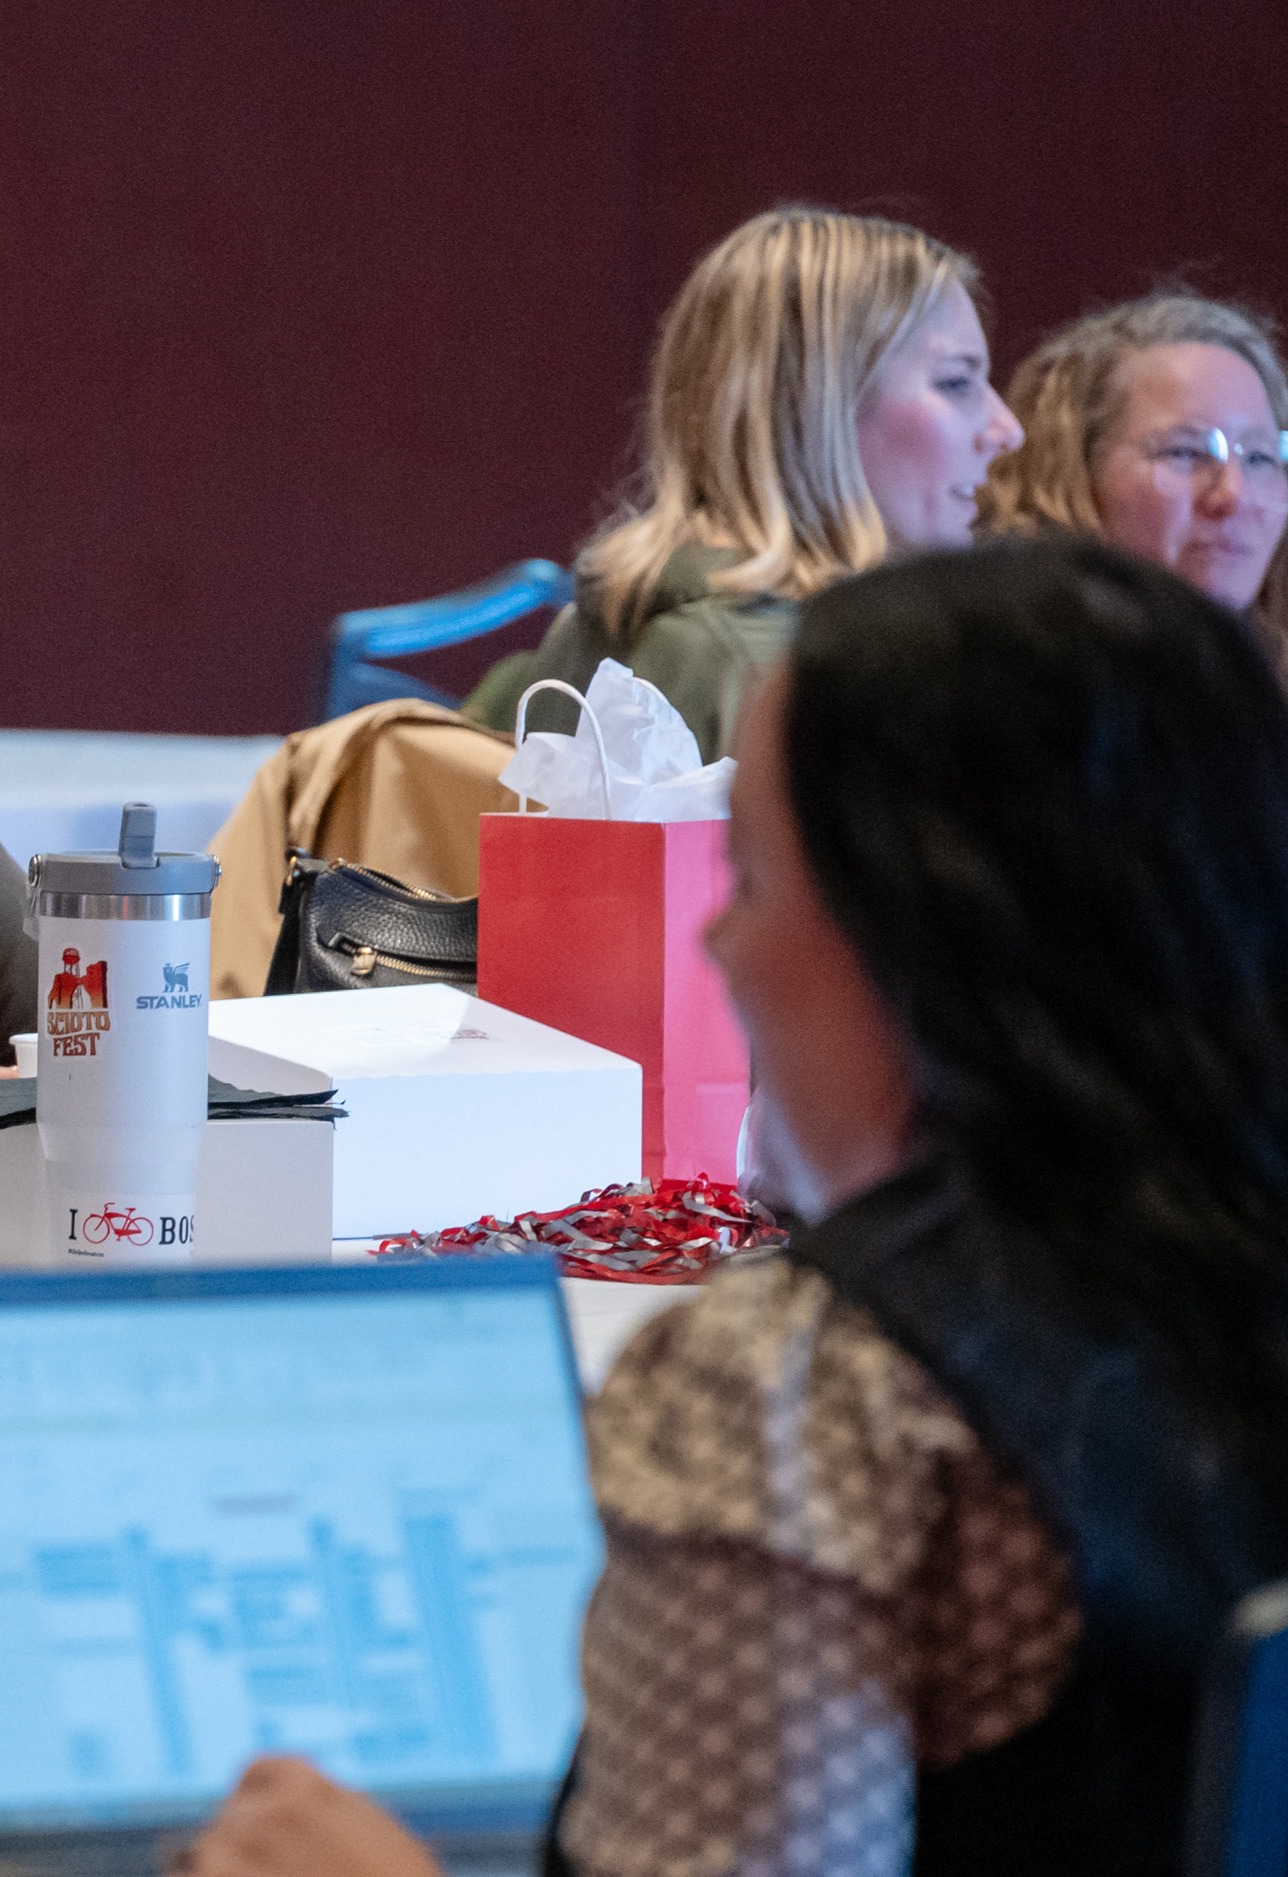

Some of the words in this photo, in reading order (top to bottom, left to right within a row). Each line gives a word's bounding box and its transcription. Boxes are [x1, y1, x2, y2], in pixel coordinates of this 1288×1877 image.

[136, 994, 202, 1009] STANLEY
[47, 1011, 110, 1035] SCIOTO
[53, 1033, 100, 1056] FEST
[68, 1208, 78, 1240] I
